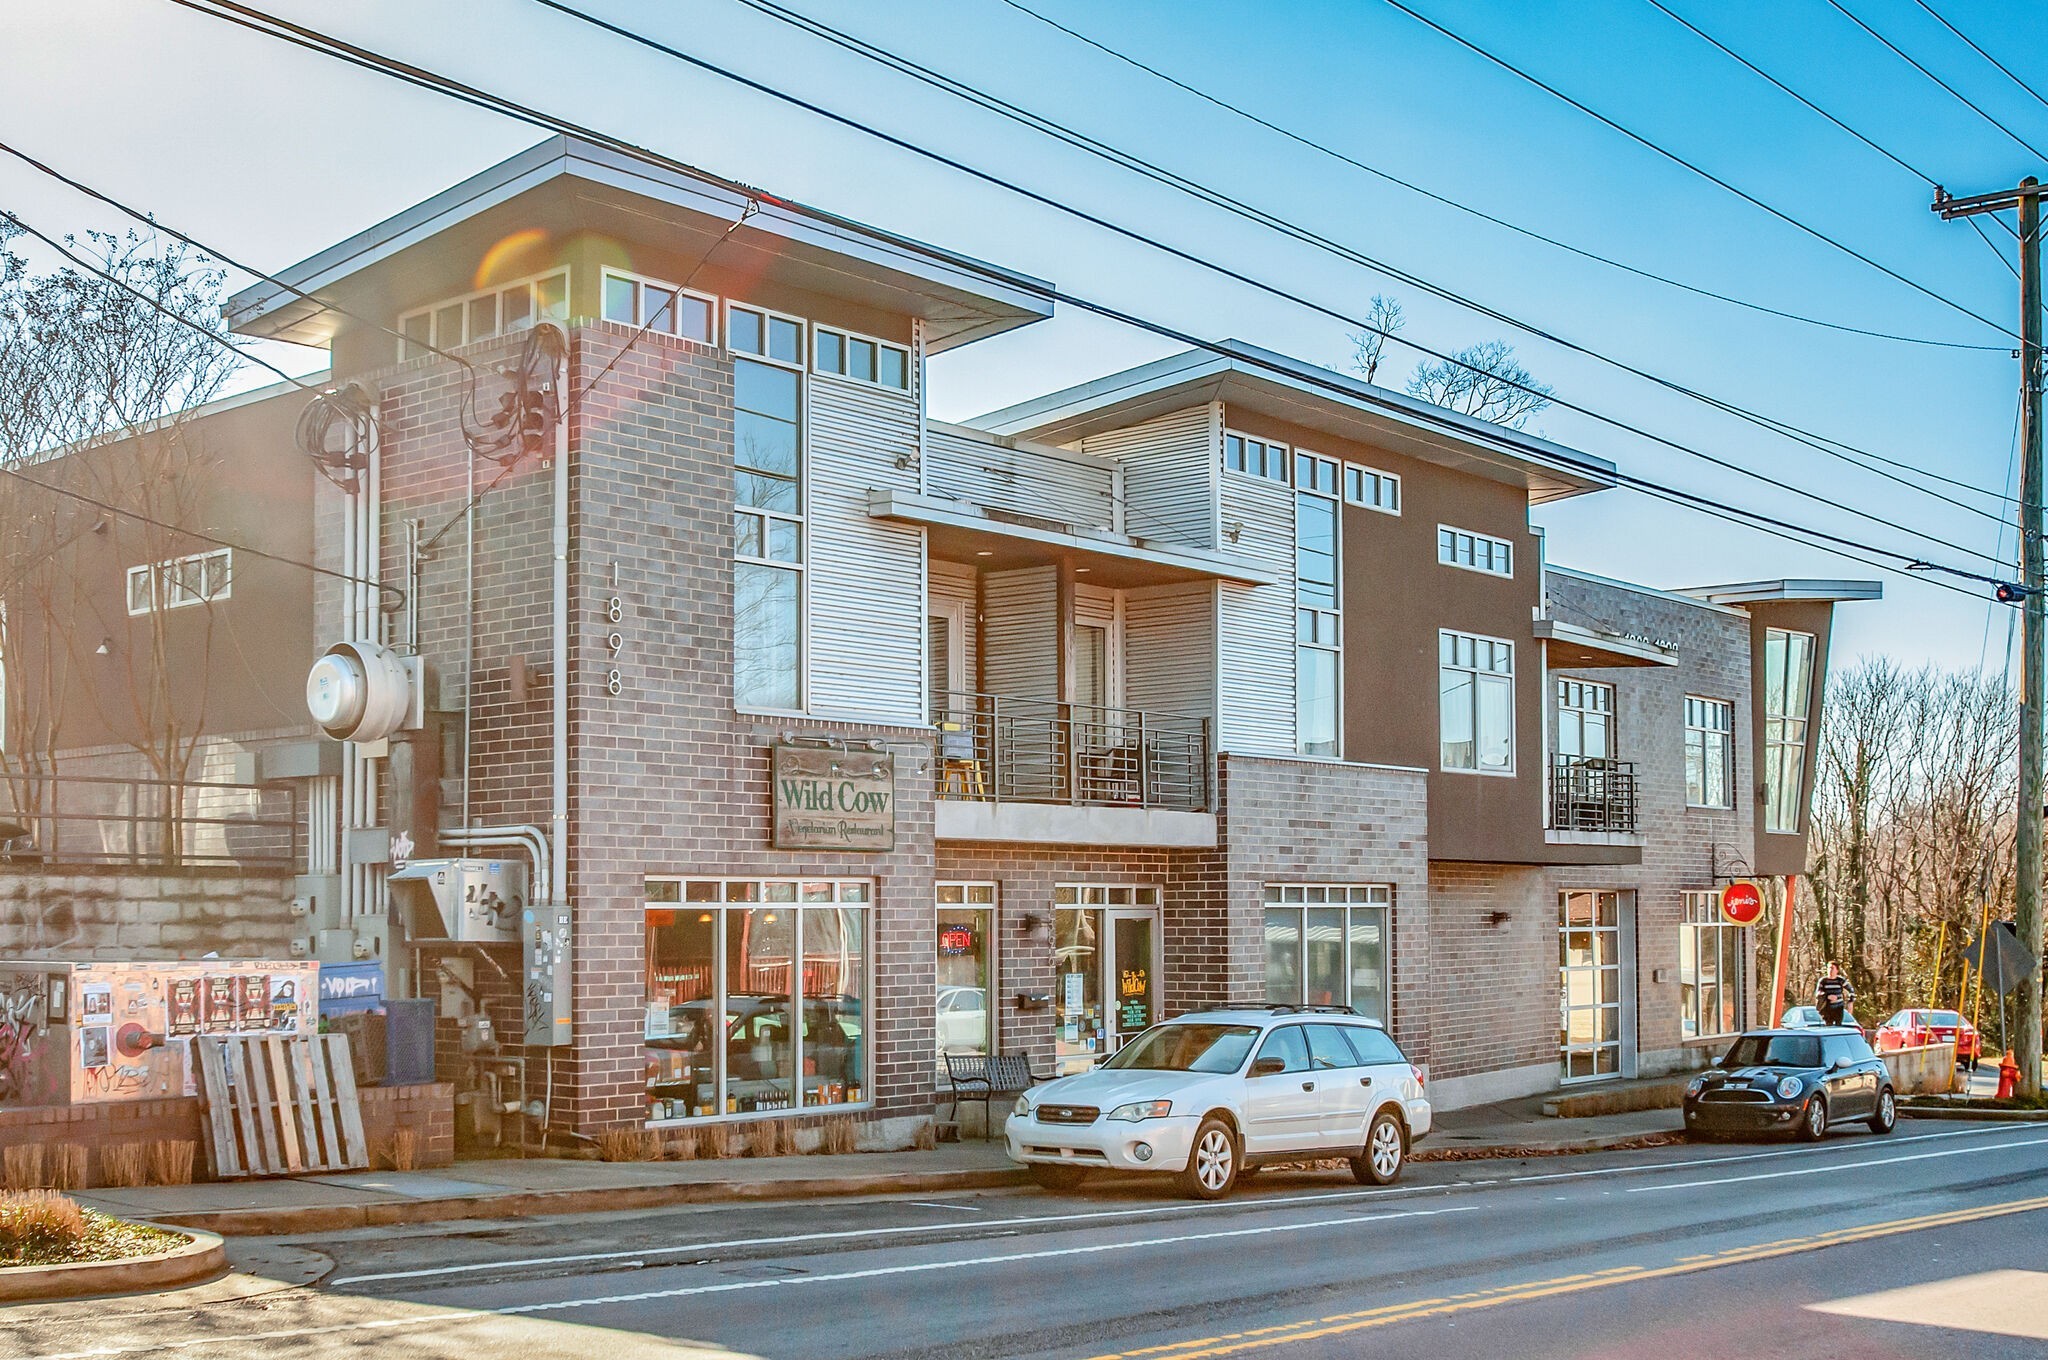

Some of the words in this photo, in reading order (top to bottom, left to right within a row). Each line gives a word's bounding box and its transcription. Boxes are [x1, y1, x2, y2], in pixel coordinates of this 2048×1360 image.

[609, 561, 623, 695] 1898
[781, 780, 834, 811] Wild
[838, 781, 890, 813] Cow
[788, 818, 837, 840] Vegetarian
[838, 820, 884, 842] Restaurant
[941, 931, 971, 947] OPEN
